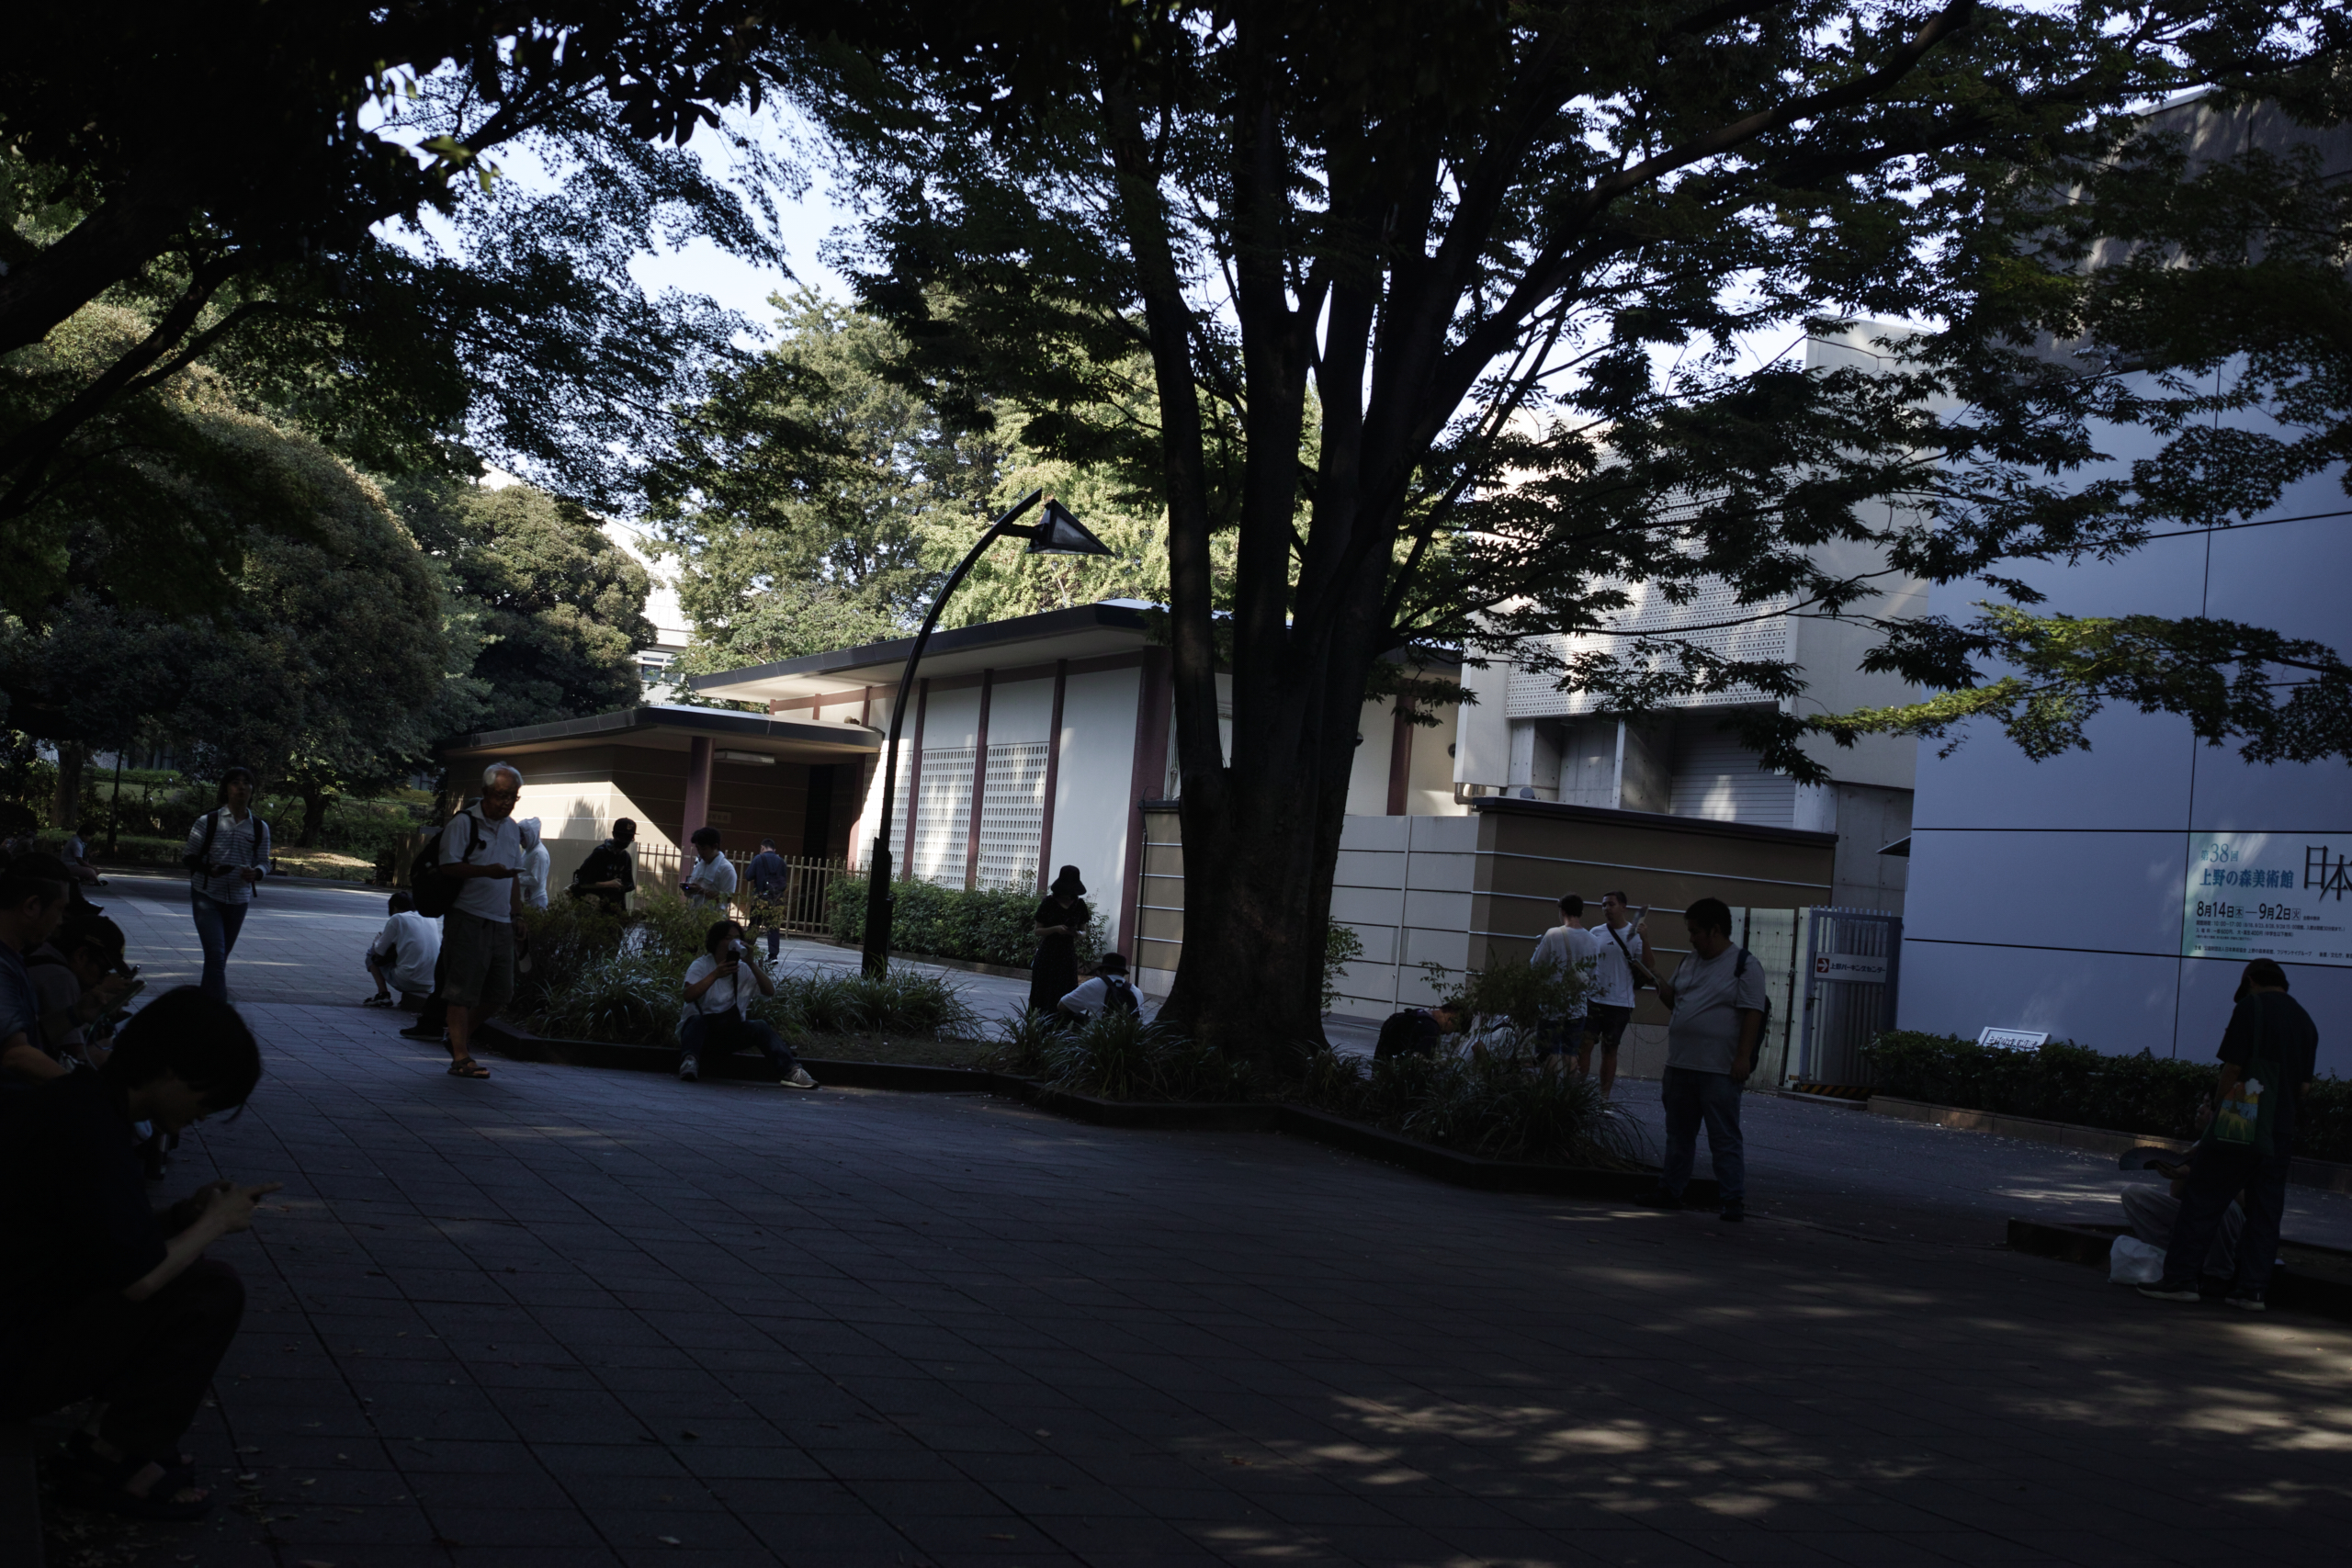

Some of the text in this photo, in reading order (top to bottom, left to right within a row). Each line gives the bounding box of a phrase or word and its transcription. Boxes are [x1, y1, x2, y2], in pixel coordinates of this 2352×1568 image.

[2200, 843, 2239, 863] 第38回
[2199, 868, 2294, 888] 上野の森美術館
[2303, 845, 2352, 902] 日本
